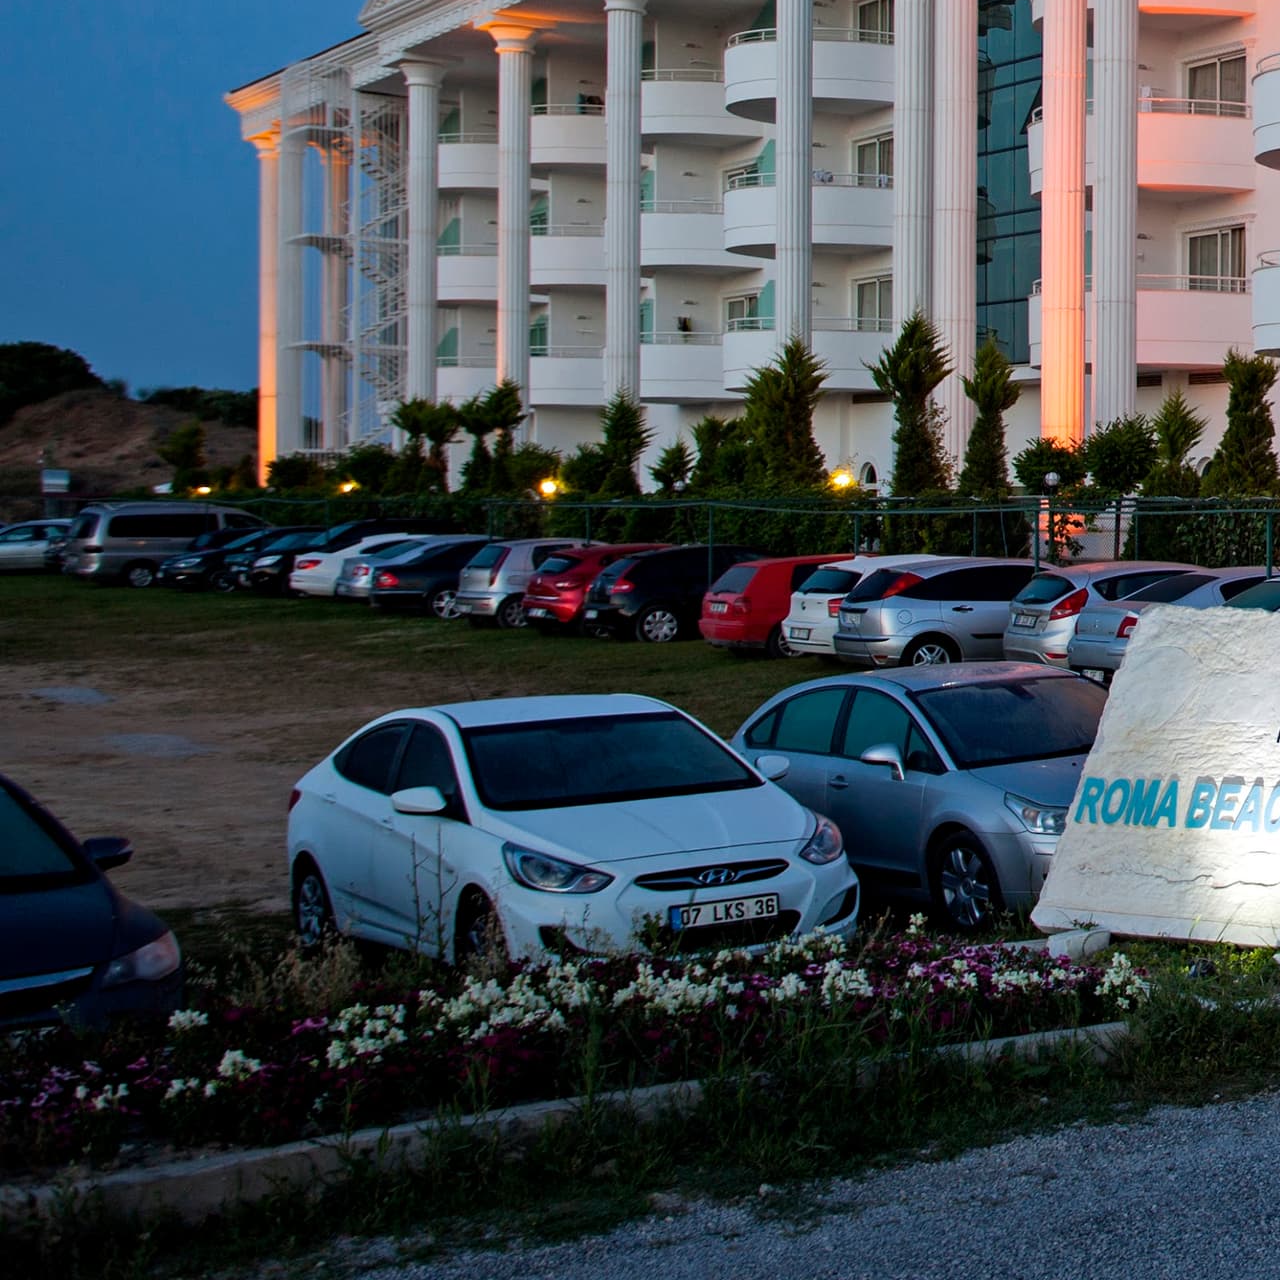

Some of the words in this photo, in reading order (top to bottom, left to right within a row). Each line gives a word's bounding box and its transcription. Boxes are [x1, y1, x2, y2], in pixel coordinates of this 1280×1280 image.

[1074, 777, 1180, 829] ROMA
[681, 907, 701, 926] 07
[713, 901, 745, 921] LKS
[755, 897, 775, 916] 36
